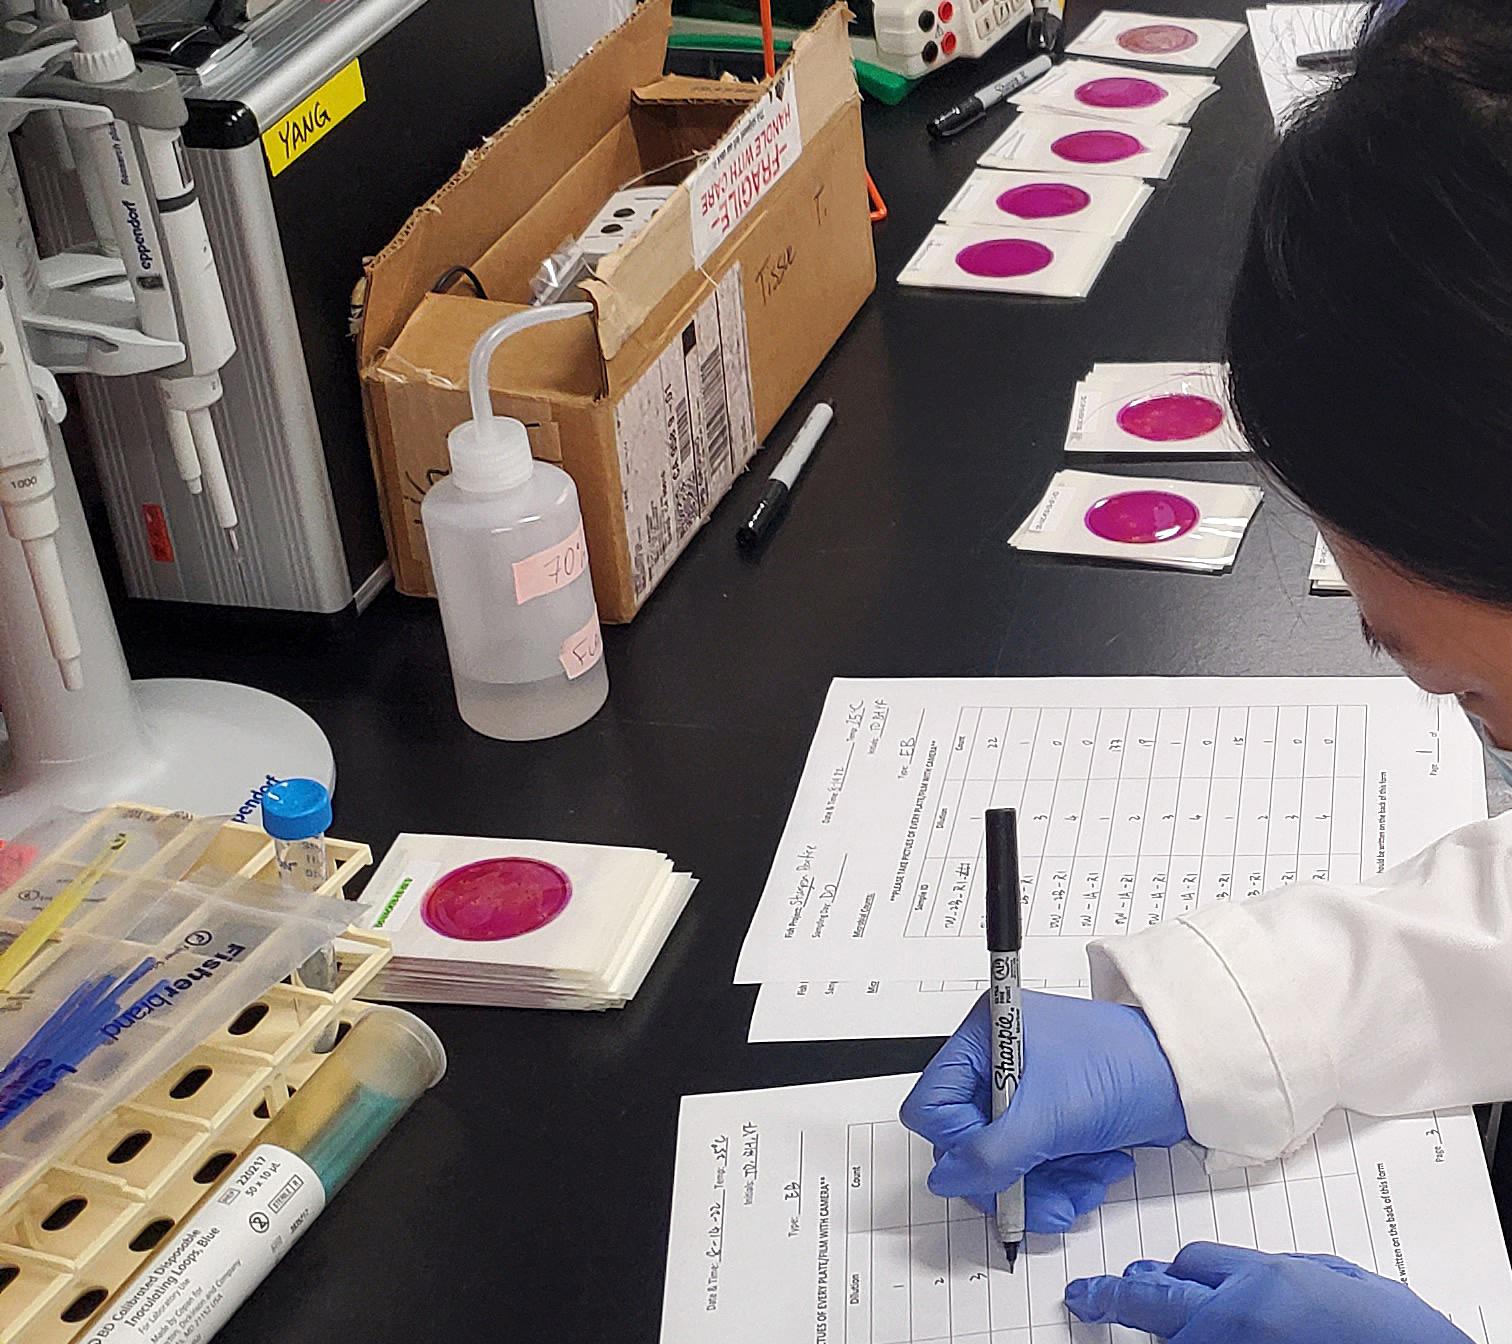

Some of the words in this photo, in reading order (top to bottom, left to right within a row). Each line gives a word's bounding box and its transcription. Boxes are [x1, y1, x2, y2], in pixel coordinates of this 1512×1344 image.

[277, 98, 332, 153] YANG
[754, 102, 792, 158] HANDLE
[730, 144, 755, 186] WITH
[700, 171, 728, 217] CARE
[121, 199, 152, 270] eppendorf
[11, 474, 38, 492] 1000
[987, 737, 998, 749] 22
[936, 808, 948, 829] Dilution
[851, 914, 868, 938] Microbial
[101, 942, 247, 1041] Fisherbrand
[1433, 1145, 1444, 1162] Page
[850, 1166, 862, 1188] Count
[1375, 1163, 1387, 1180] form
[1378, 1181, 1390, 1195] this
[1385, 1204, 1395, 1223] back
[818, 1218, 830, 1239] WITH
[1387, 1223, 1398, 1236] the
[817, 1240, 831, 1284] PLATE/FILM
[1394, 1248, 1408, 1276] written
[101, 1322, 115, 1339] BD
[112, 1274, 159, 1321] Calibrated
[154, 1229, 201, 1277] Disposable
[124, 1275, 178, 1328] Inoculating
[197, 1226, 221, 1248] Blue
[934, 1277, 945, 1285] 2
[969, 1272, 988, 1281] 3
[816, 1284, 829, 1309] EVERY
[849, 1274, 861, 1305] Dilution
[705, 1293, 718, 1311] Date
